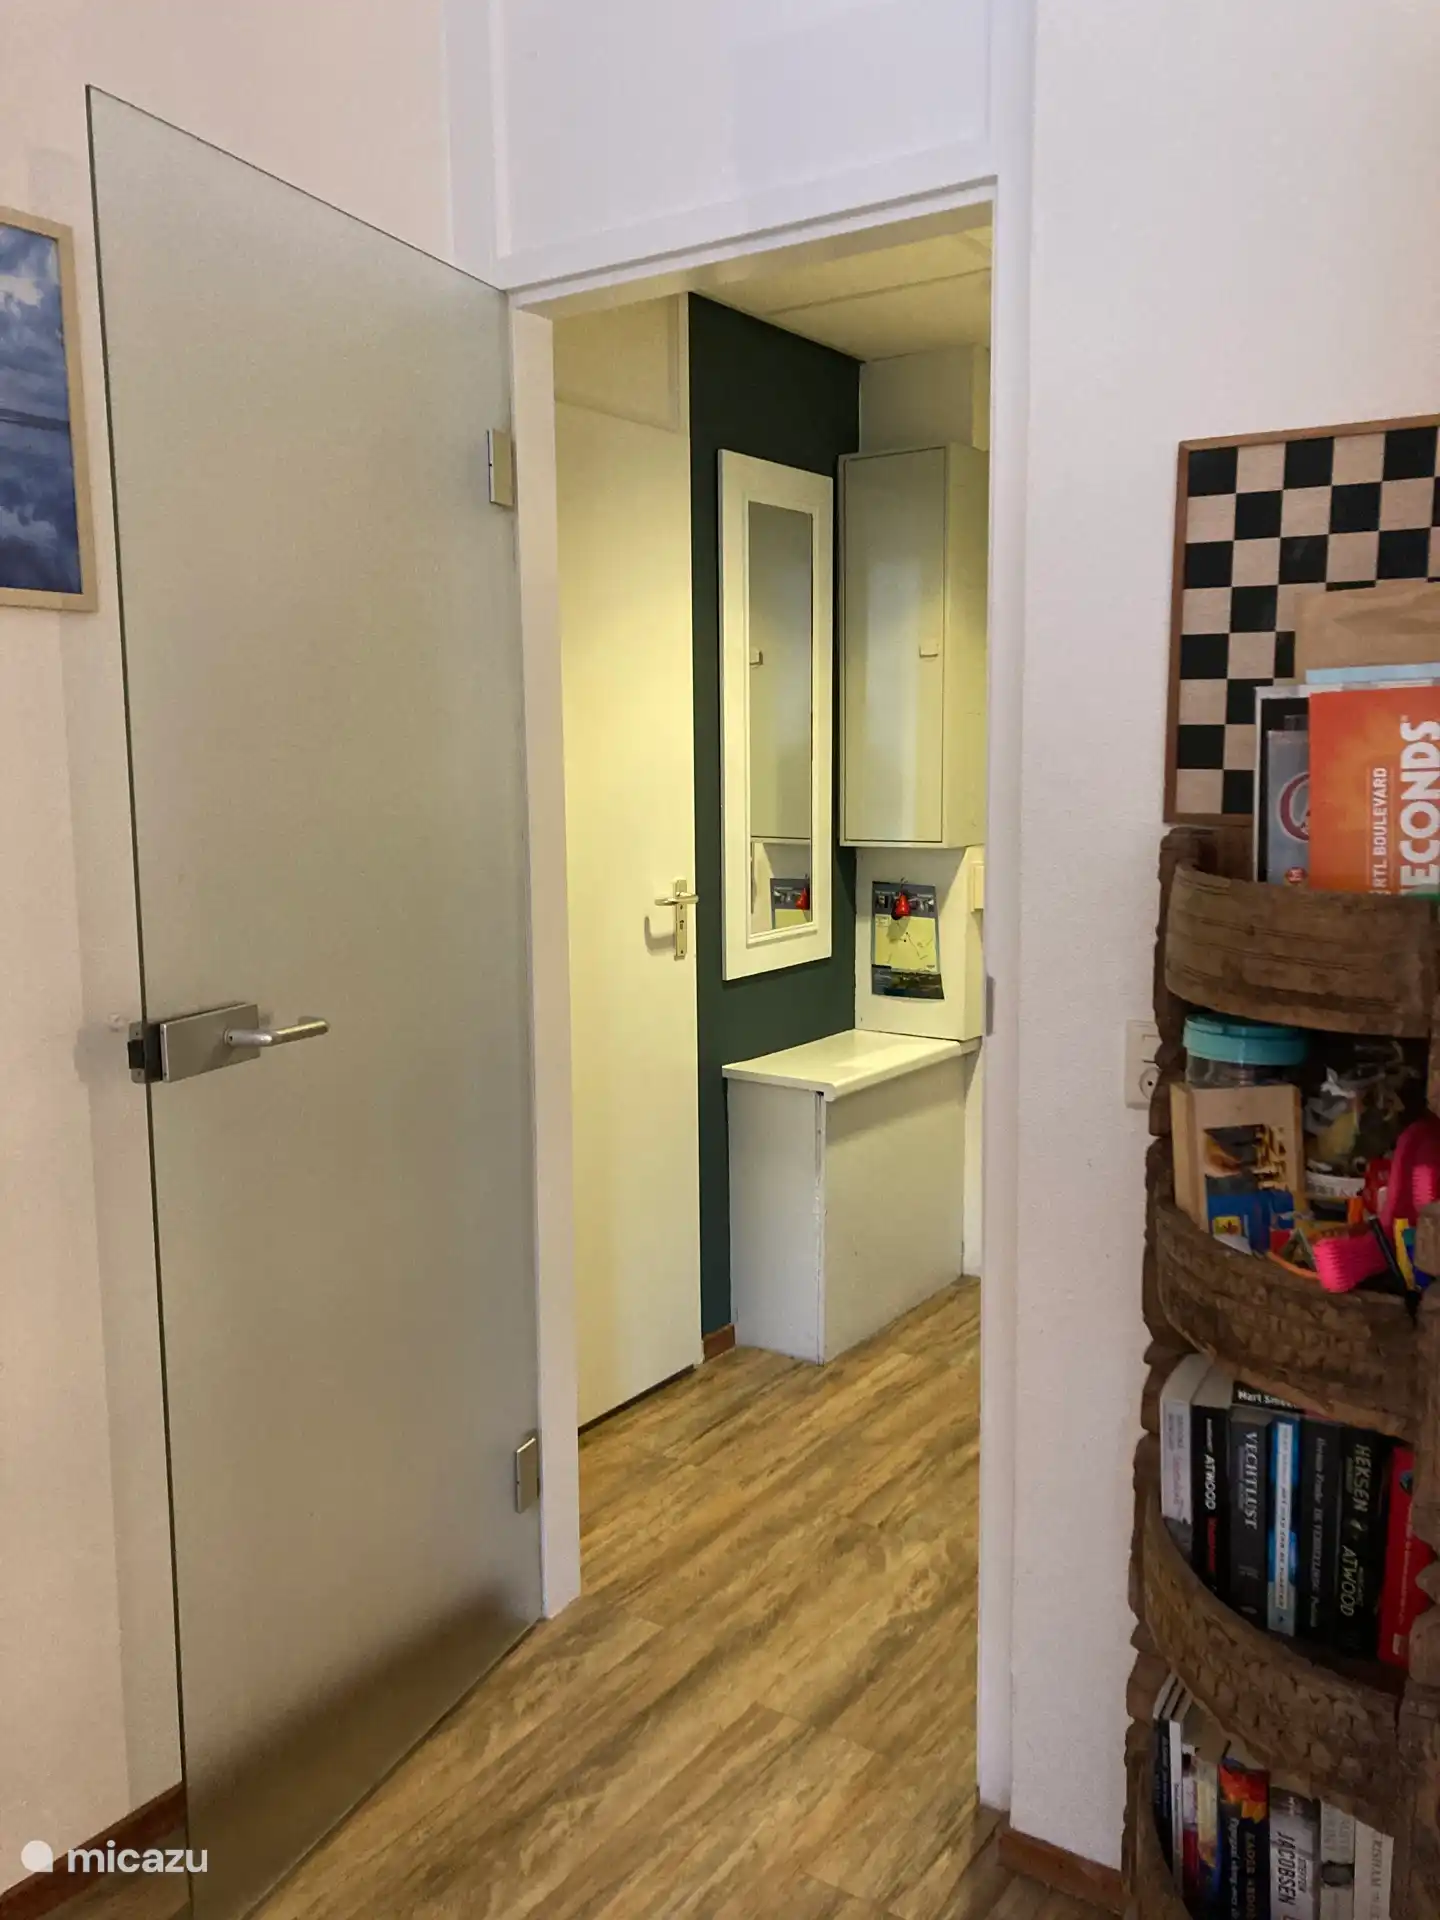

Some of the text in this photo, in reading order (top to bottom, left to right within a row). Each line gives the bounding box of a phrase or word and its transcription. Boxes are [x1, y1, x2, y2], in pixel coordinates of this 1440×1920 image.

[1372, 767, 1388, 889] RTL BOULEVARD
[1399, 718, 1440, 896] ECONDS
[1203, 1453, 1218, 1511] ATWOOD
[1243, 1431, 1260, 1531] VECHTLUST
[1351, 1443, 1373, 1513] HEKSEN
[1339, 1544, 1359, 1617] ATWOOD
[1277, 1831, 1297, 1906] JACOBSEN
